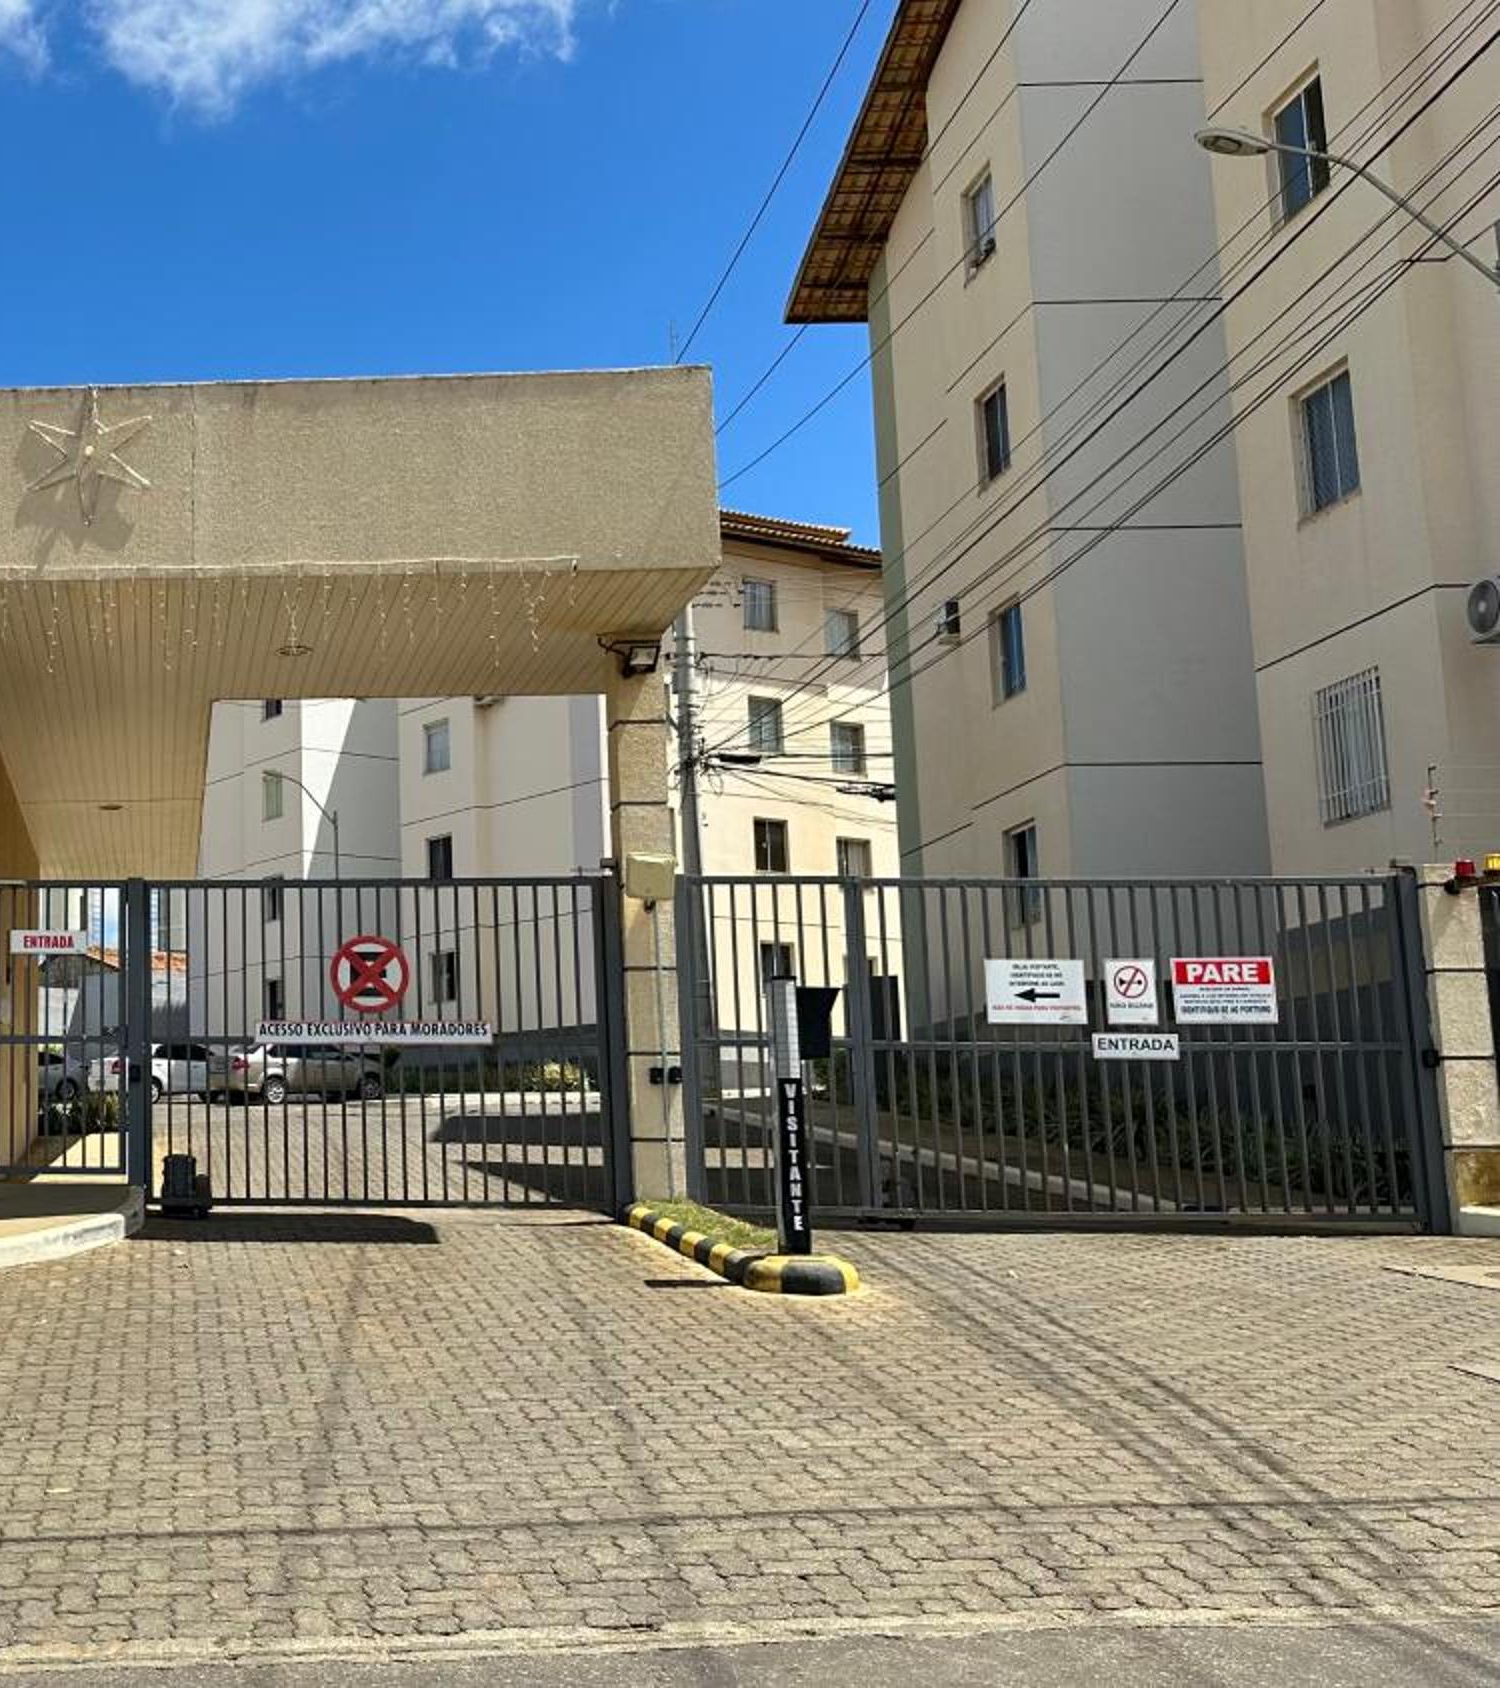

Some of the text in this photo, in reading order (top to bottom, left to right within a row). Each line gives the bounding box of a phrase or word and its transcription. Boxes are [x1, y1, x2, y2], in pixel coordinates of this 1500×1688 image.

[23, 935, 74, 948] ENTRADA
[1185, 963, 1260, 983] PARE
[259, 1023, 488, 1036] ACESSO EXCLUSIVO PARA MORADORES
[1097, 1037, 1174, 1050] ENTRADA
[783, 1083, 803, 1231] VISITANTE
